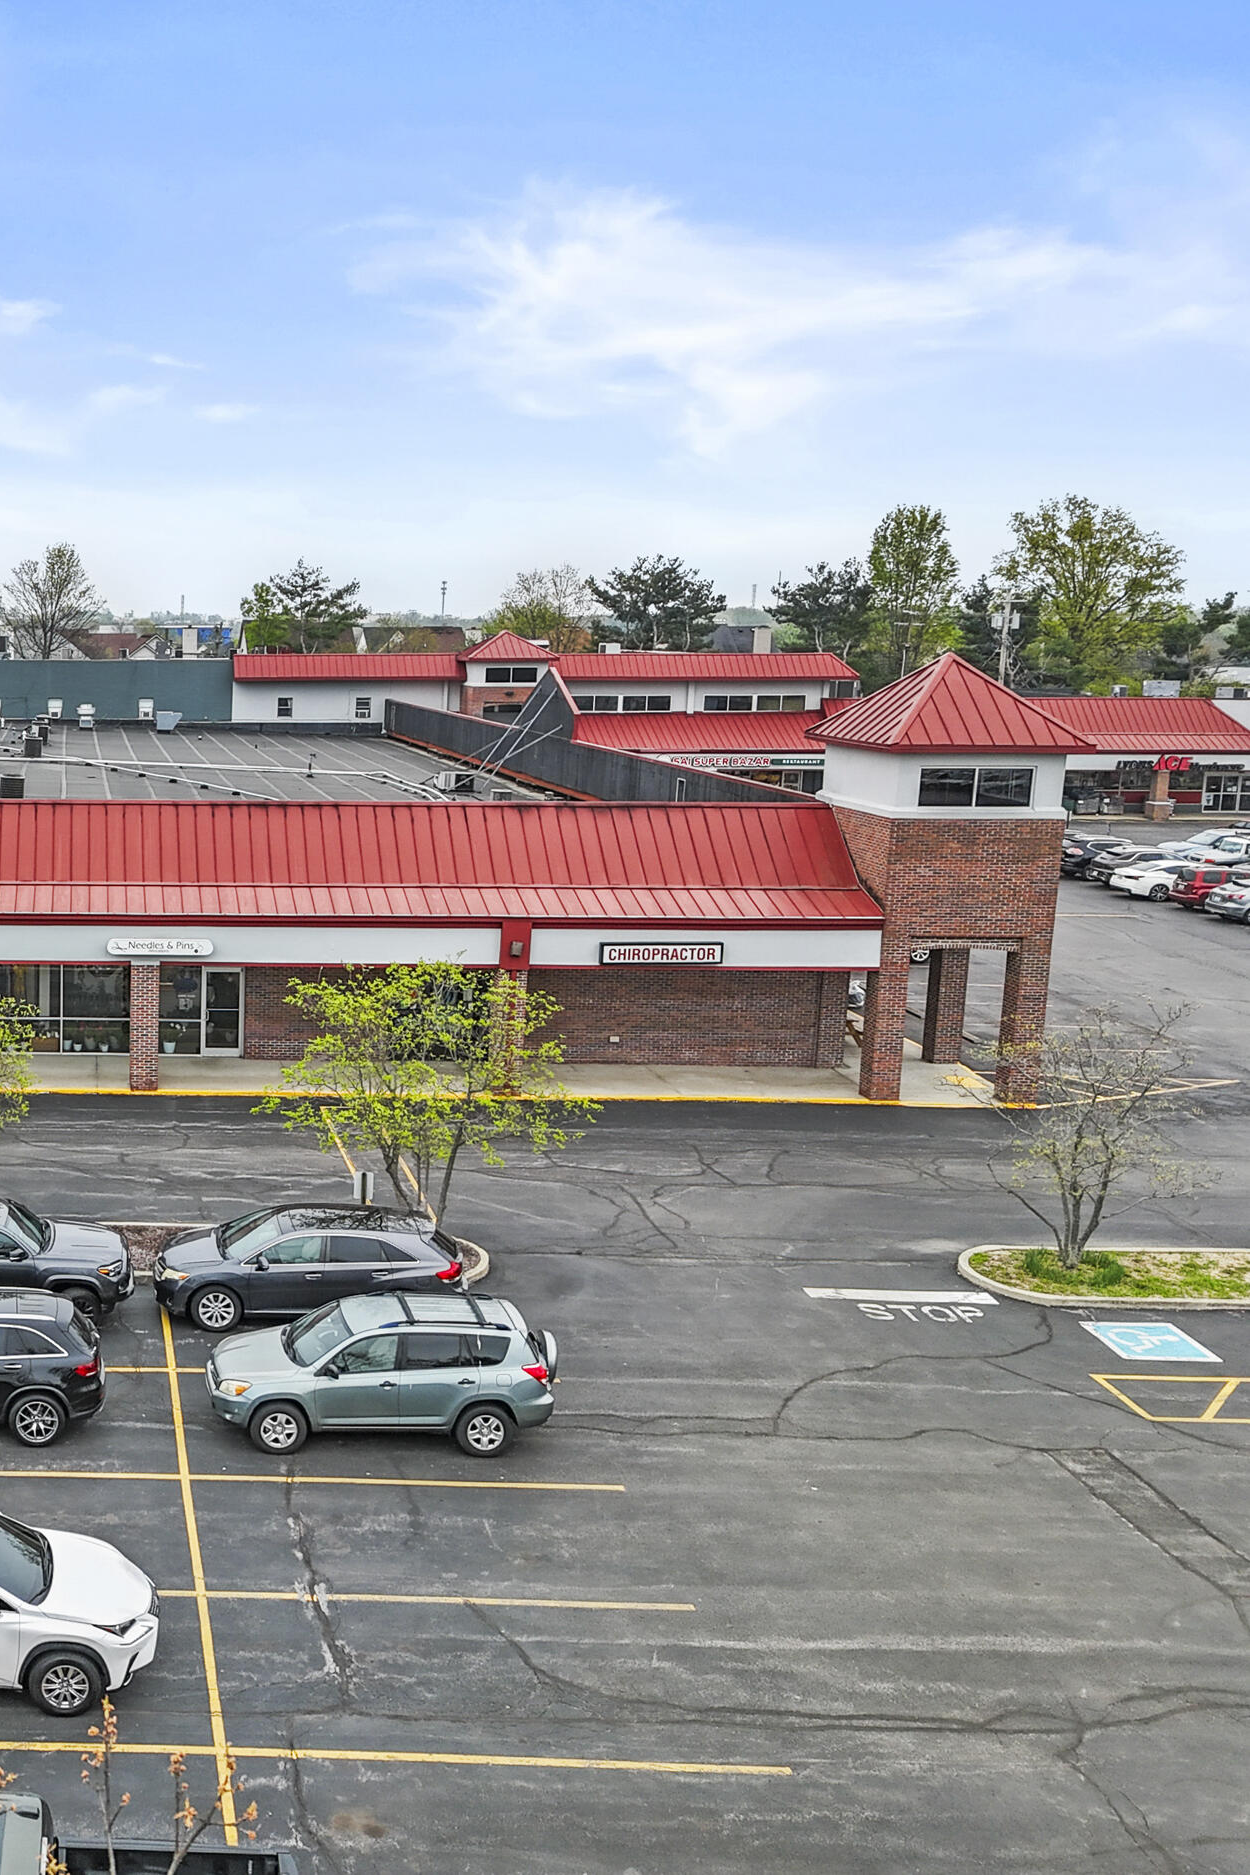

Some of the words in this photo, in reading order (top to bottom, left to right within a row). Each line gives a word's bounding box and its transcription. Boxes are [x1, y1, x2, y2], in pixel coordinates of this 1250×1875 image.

[672, 756, 691, 766] SAI
[694, 756, 730, 767] SUPER
[731, 757, 771, 767] BAZAR
[1152, 754, 1193, 771] ACE
[128, 941, 164, 950] Needles
[176, 941, 195, 950] Pins
[608, 948, 716, 961] CHIROPRACTOR
[857, 1303, 984, 1323] STOP
